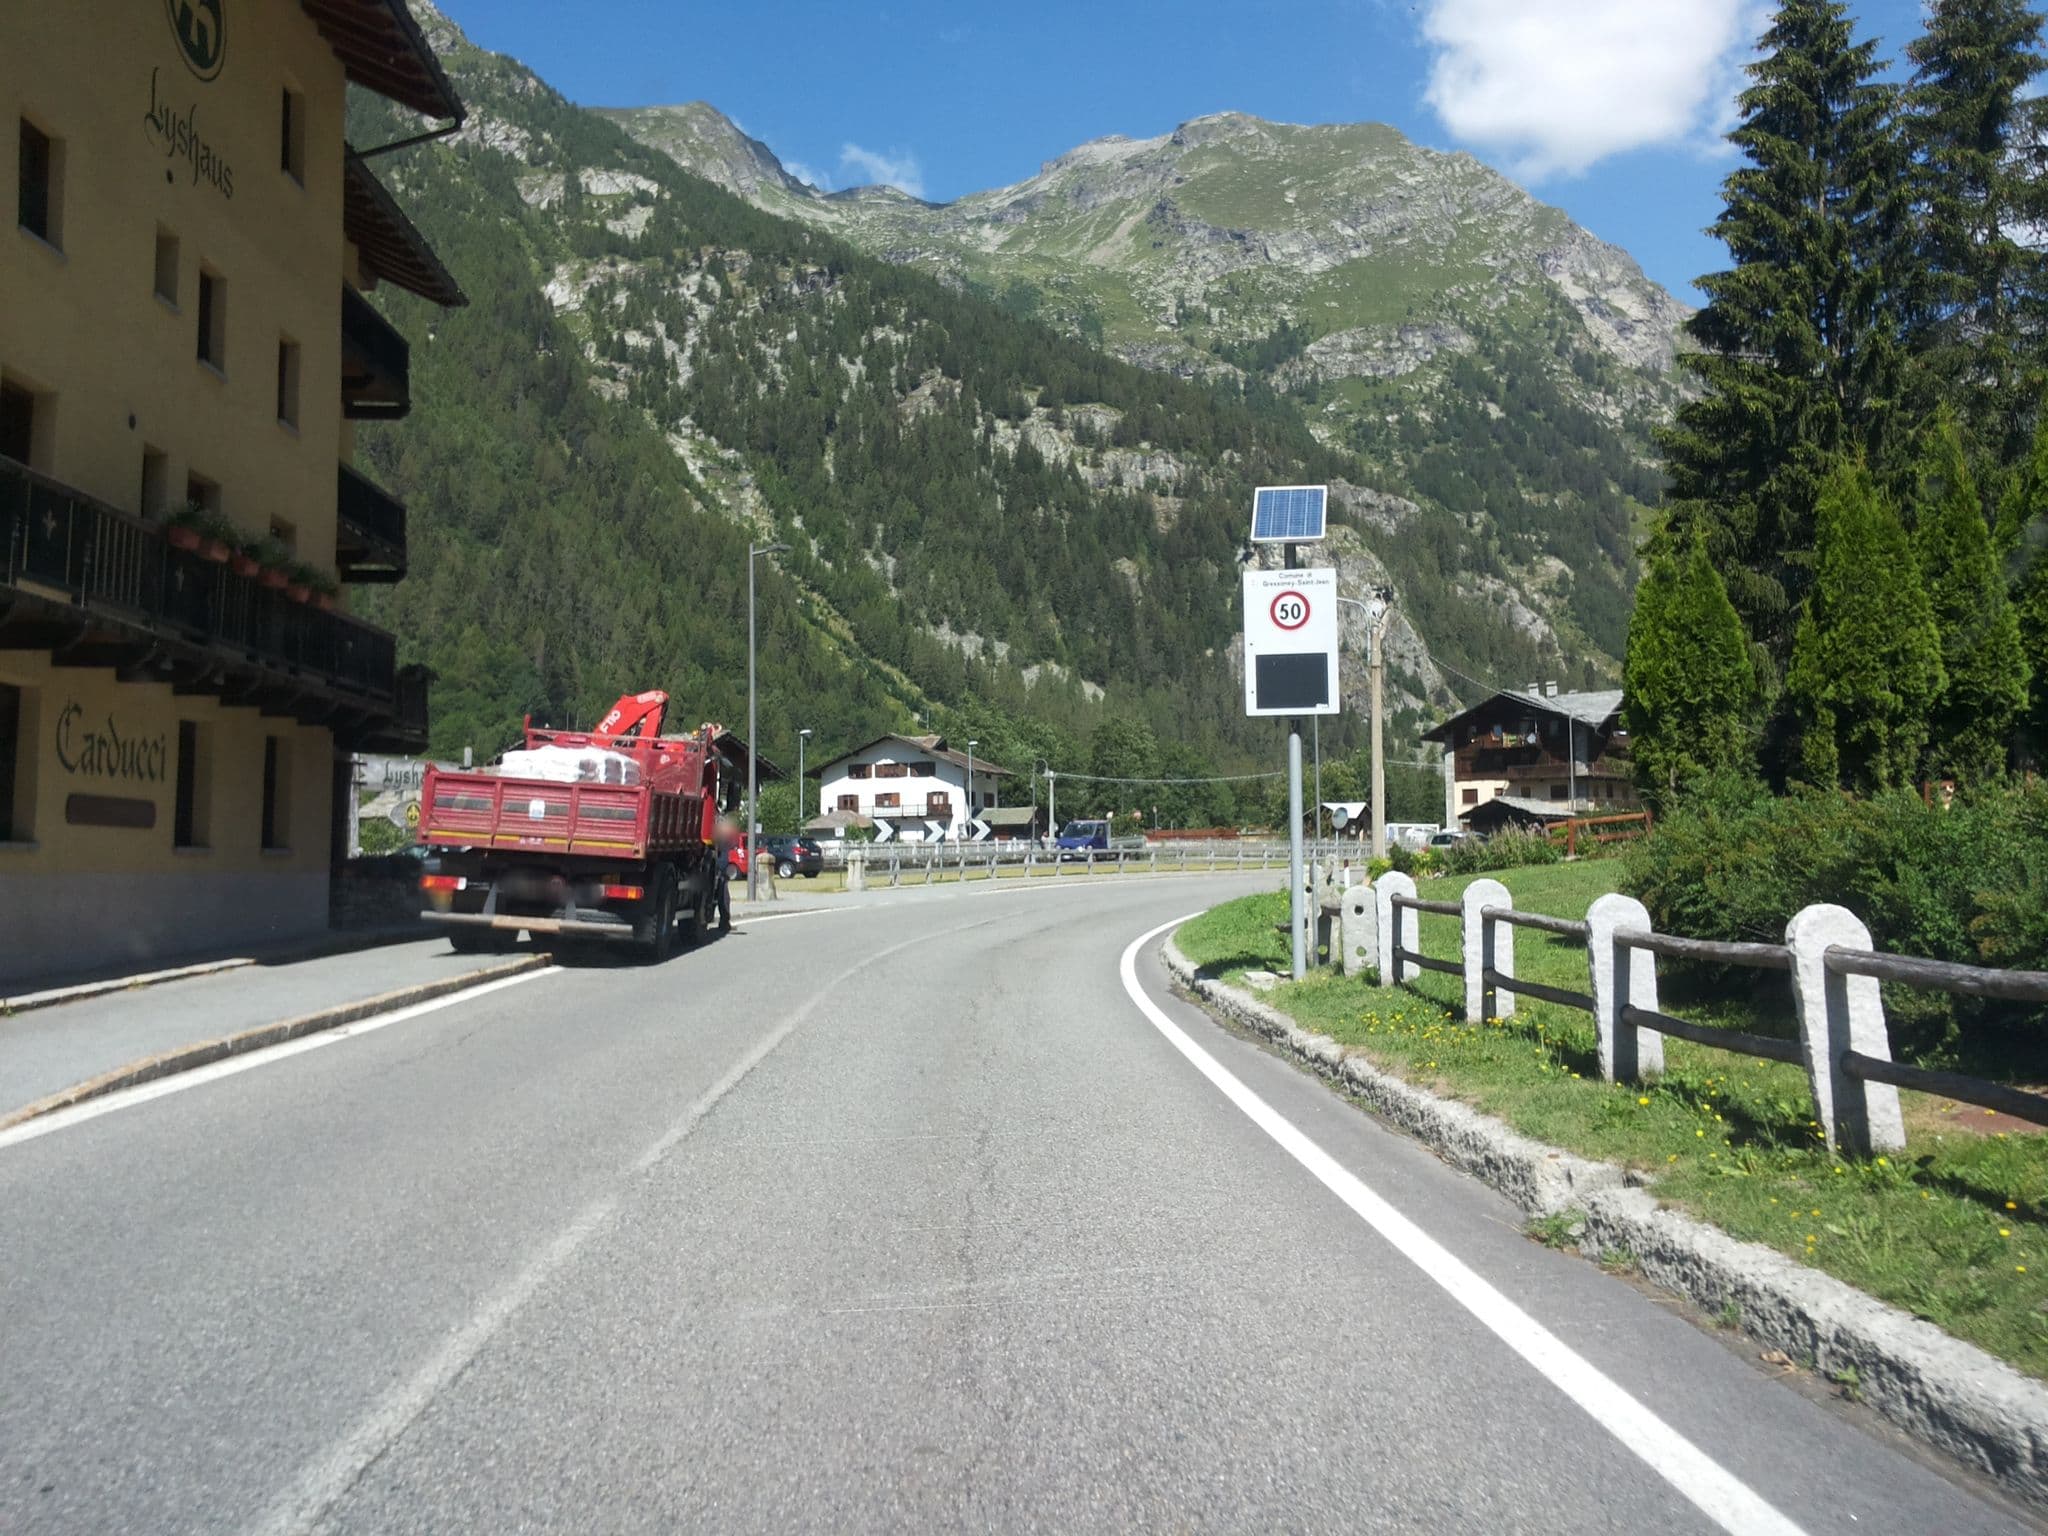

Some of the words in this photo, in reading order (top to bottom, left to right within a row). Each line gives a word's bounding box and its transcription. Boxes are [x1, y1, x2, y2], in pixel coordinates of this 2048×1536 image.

[145, 66, 233, 200] Lyshaus
[1280, 603, 1301, 620] 50
[56, 695, 166, 782] Carducci
